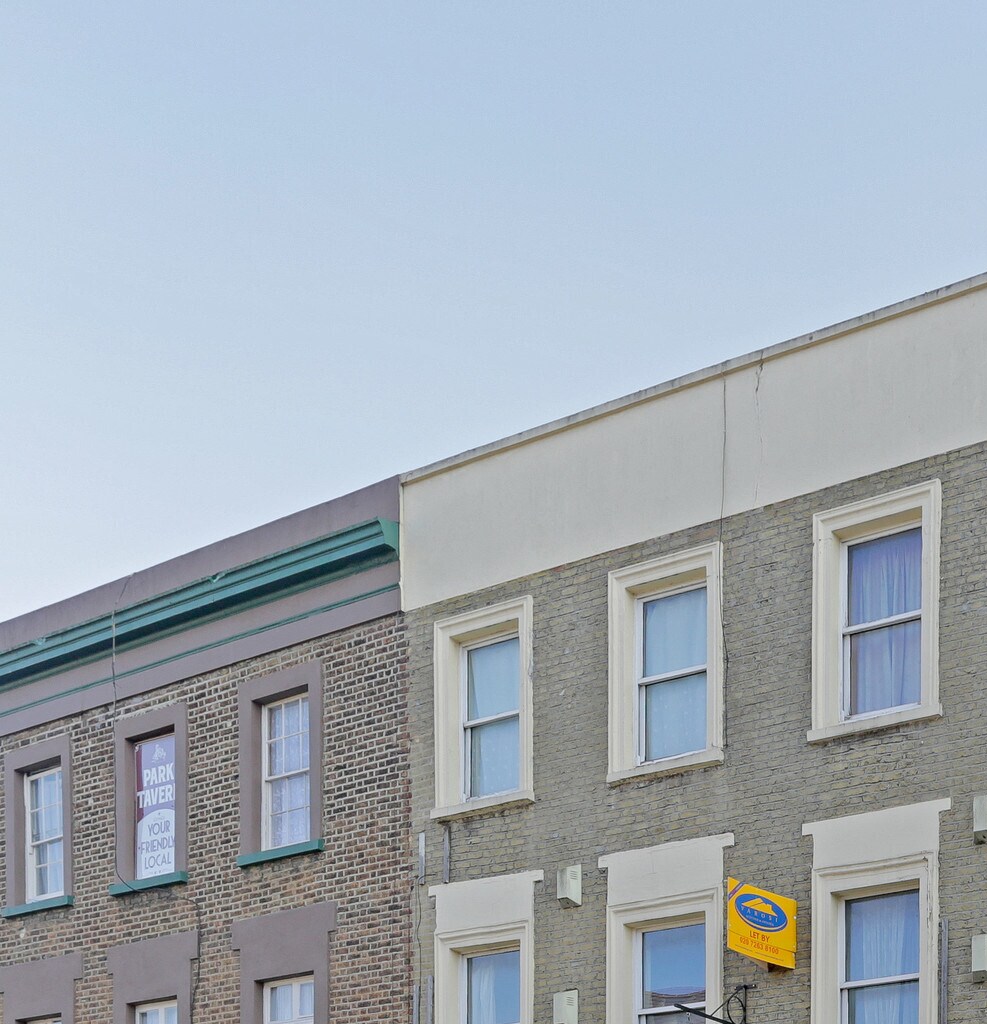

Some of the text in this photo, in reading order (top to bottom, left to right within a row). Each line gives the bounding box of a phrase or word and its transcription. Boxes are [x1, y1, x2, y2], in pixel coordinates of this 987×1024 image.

[143, 762, 175, 787] PARK
[147, 820, 171, 836] YOUR
[144, 854, 172, 870] LOCAL
[749, 930, 770, 943] LET BY
